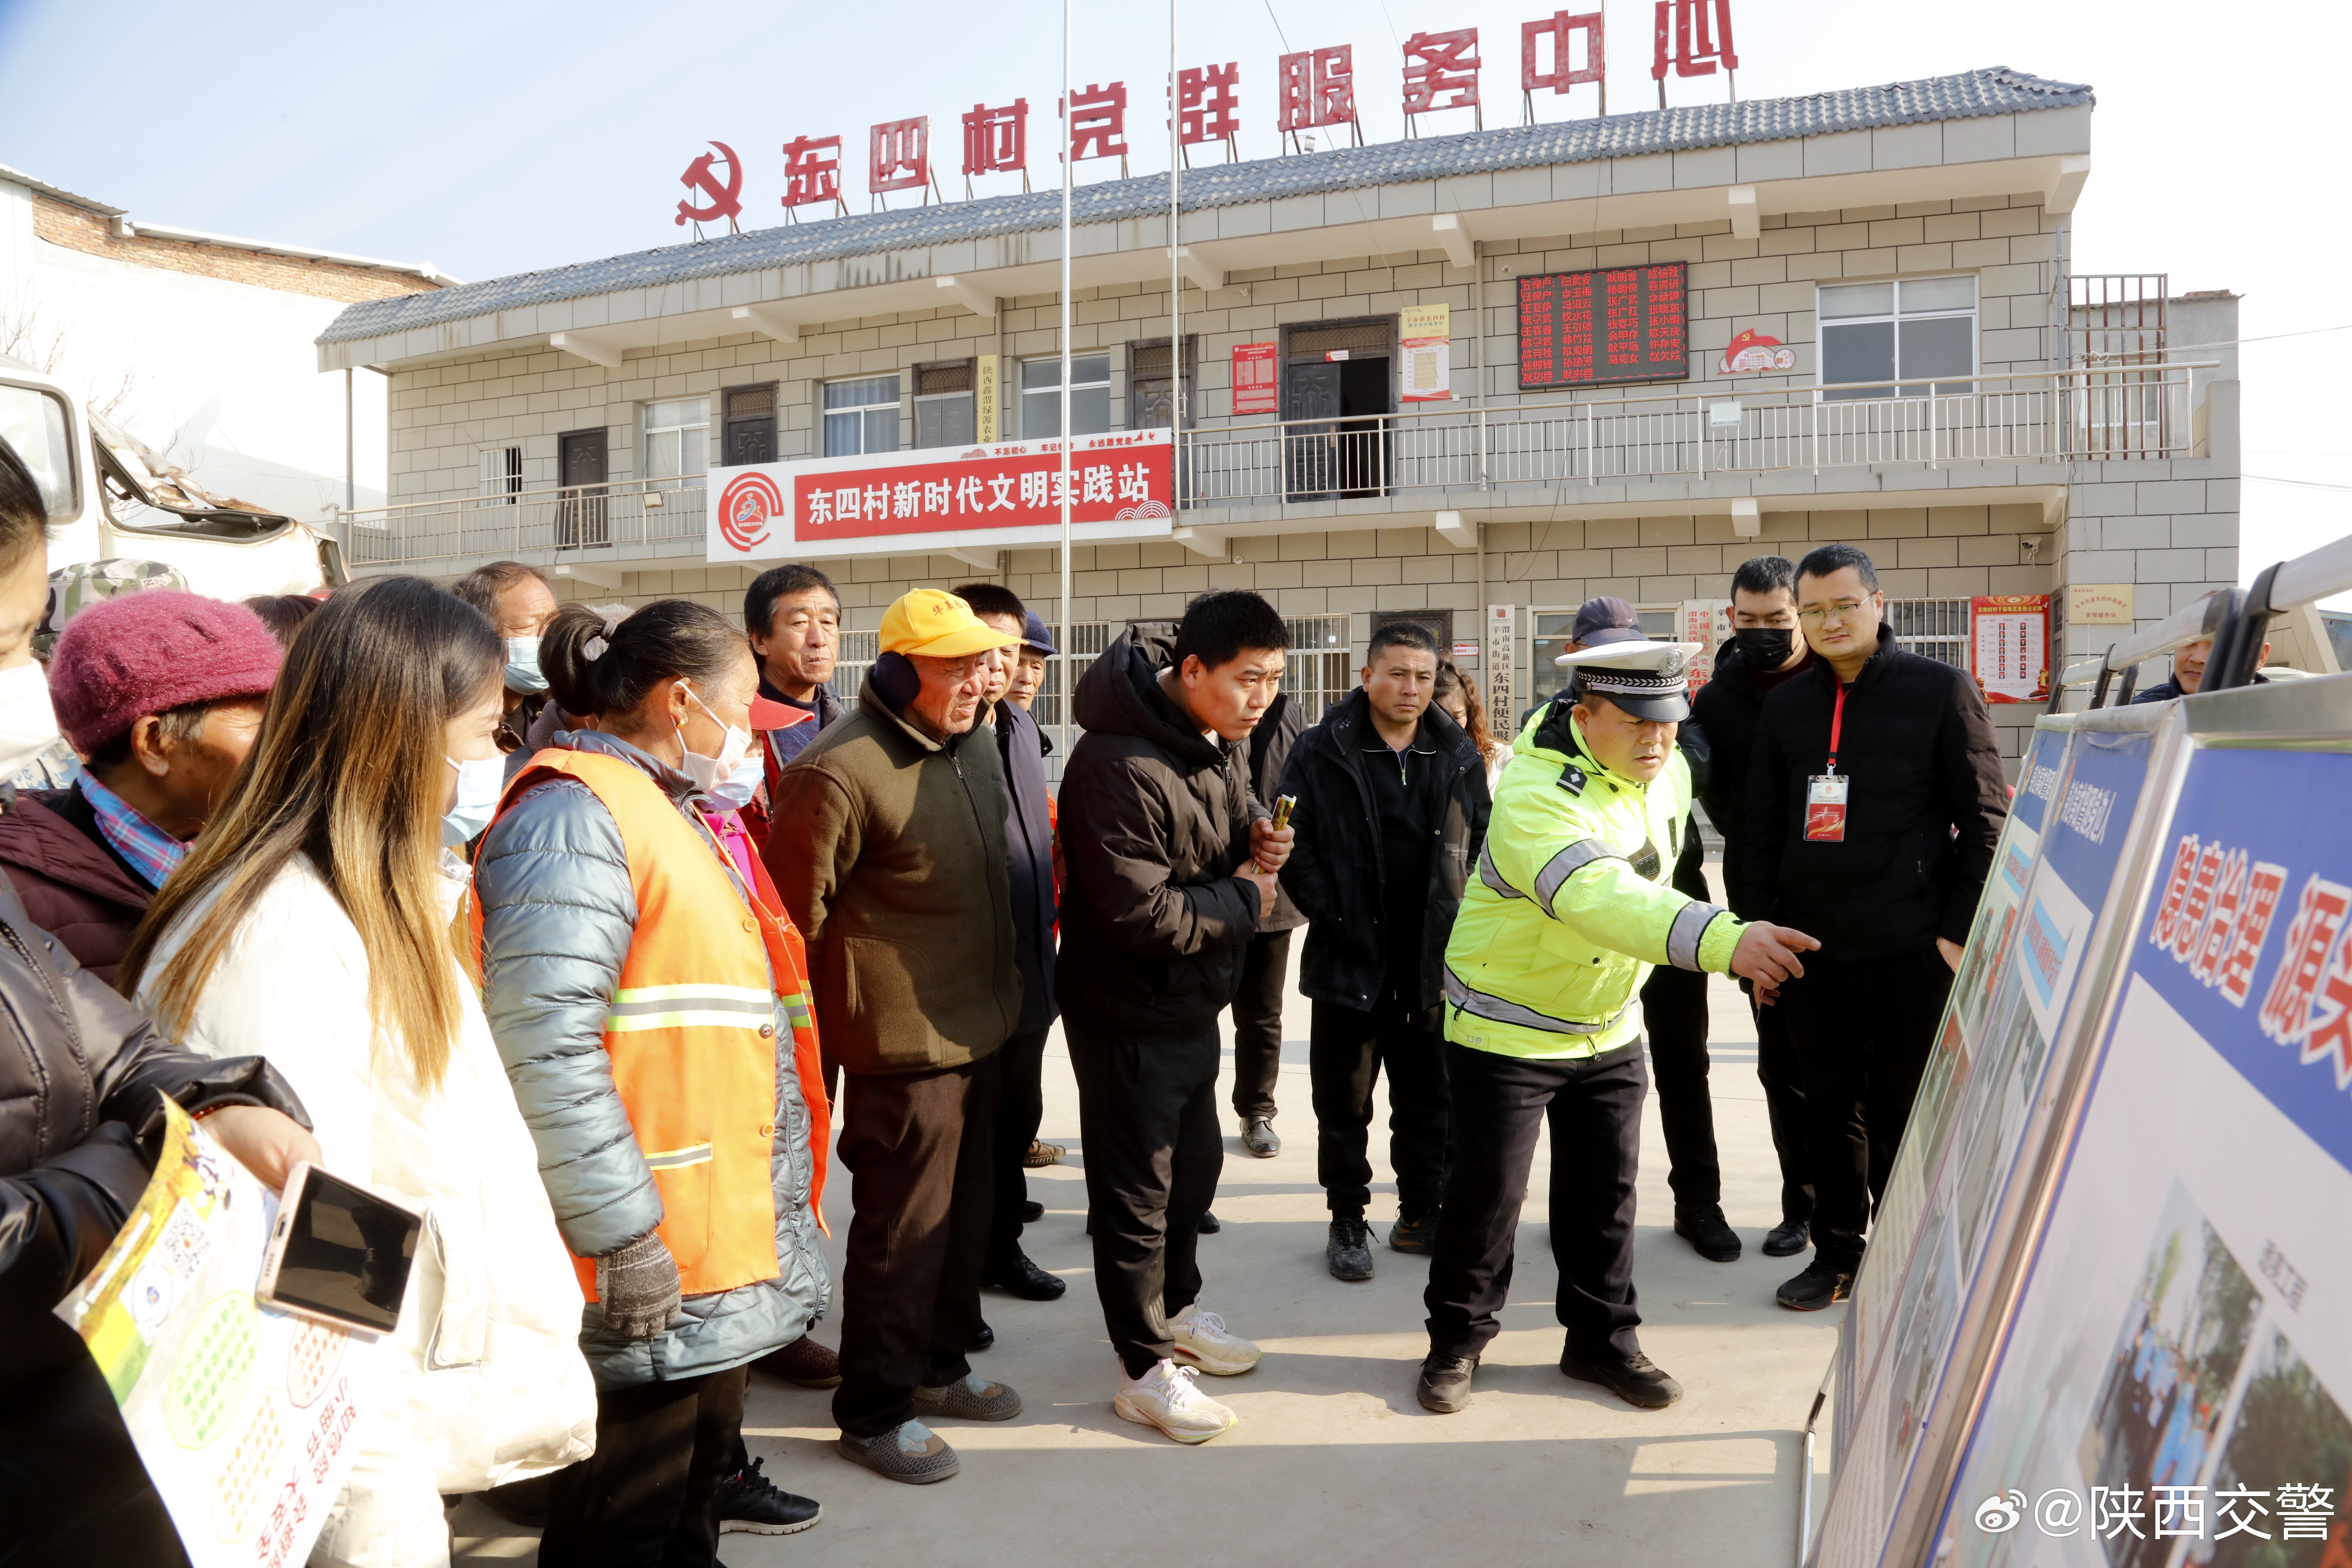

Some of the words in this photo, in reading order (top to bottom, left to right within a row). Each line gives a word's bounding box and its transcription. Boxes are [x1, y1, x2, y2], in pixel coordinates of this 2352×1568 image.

[781, 0, 1738, 208] 东四村党群服务中心
[1607, 294, 1638, 306] 张广武
[1522, 313, 1552, 325] 张学武
[1607, 305, 1638, 318] 张广红
[1648, 302, 1679, 314] 张晓东
[1522, 325, 1552, 336] 王春香
[1648, 314, 1679, 326] 张小明
[1522, 336, 1552, 347] 陈学武
[1607, 329, 1638, 341] 余甲存
[1562, 344, 1592, 356] 陈海明
[1607, 341, 1638, 353] 耿平远
[1649, 338, 1680, 350] 许存安
[1608, 352, 1639, 365] 高花女
[982, 366, 992, 443] 陕西鑫渭绿源农业
[995, 446, 1026, 455] 不忘初心
[1041, 442, 1074, 452] 牢记
[1089, 437, 1133, 448] 永远跟党走
[807, 463, 1150, 525] 东四村新时代文明实践站
[2075, 596, 2127, 609] 辛市街道东四村网格化
[1492, 626, 1500, 670] 辛市街道
[1502, 626, 1510, 670] 渭南高新区
[1688, 611, 1698, 666] 渭南高新区街道
[2149, 833, 2289, 1009] 隐患治理
